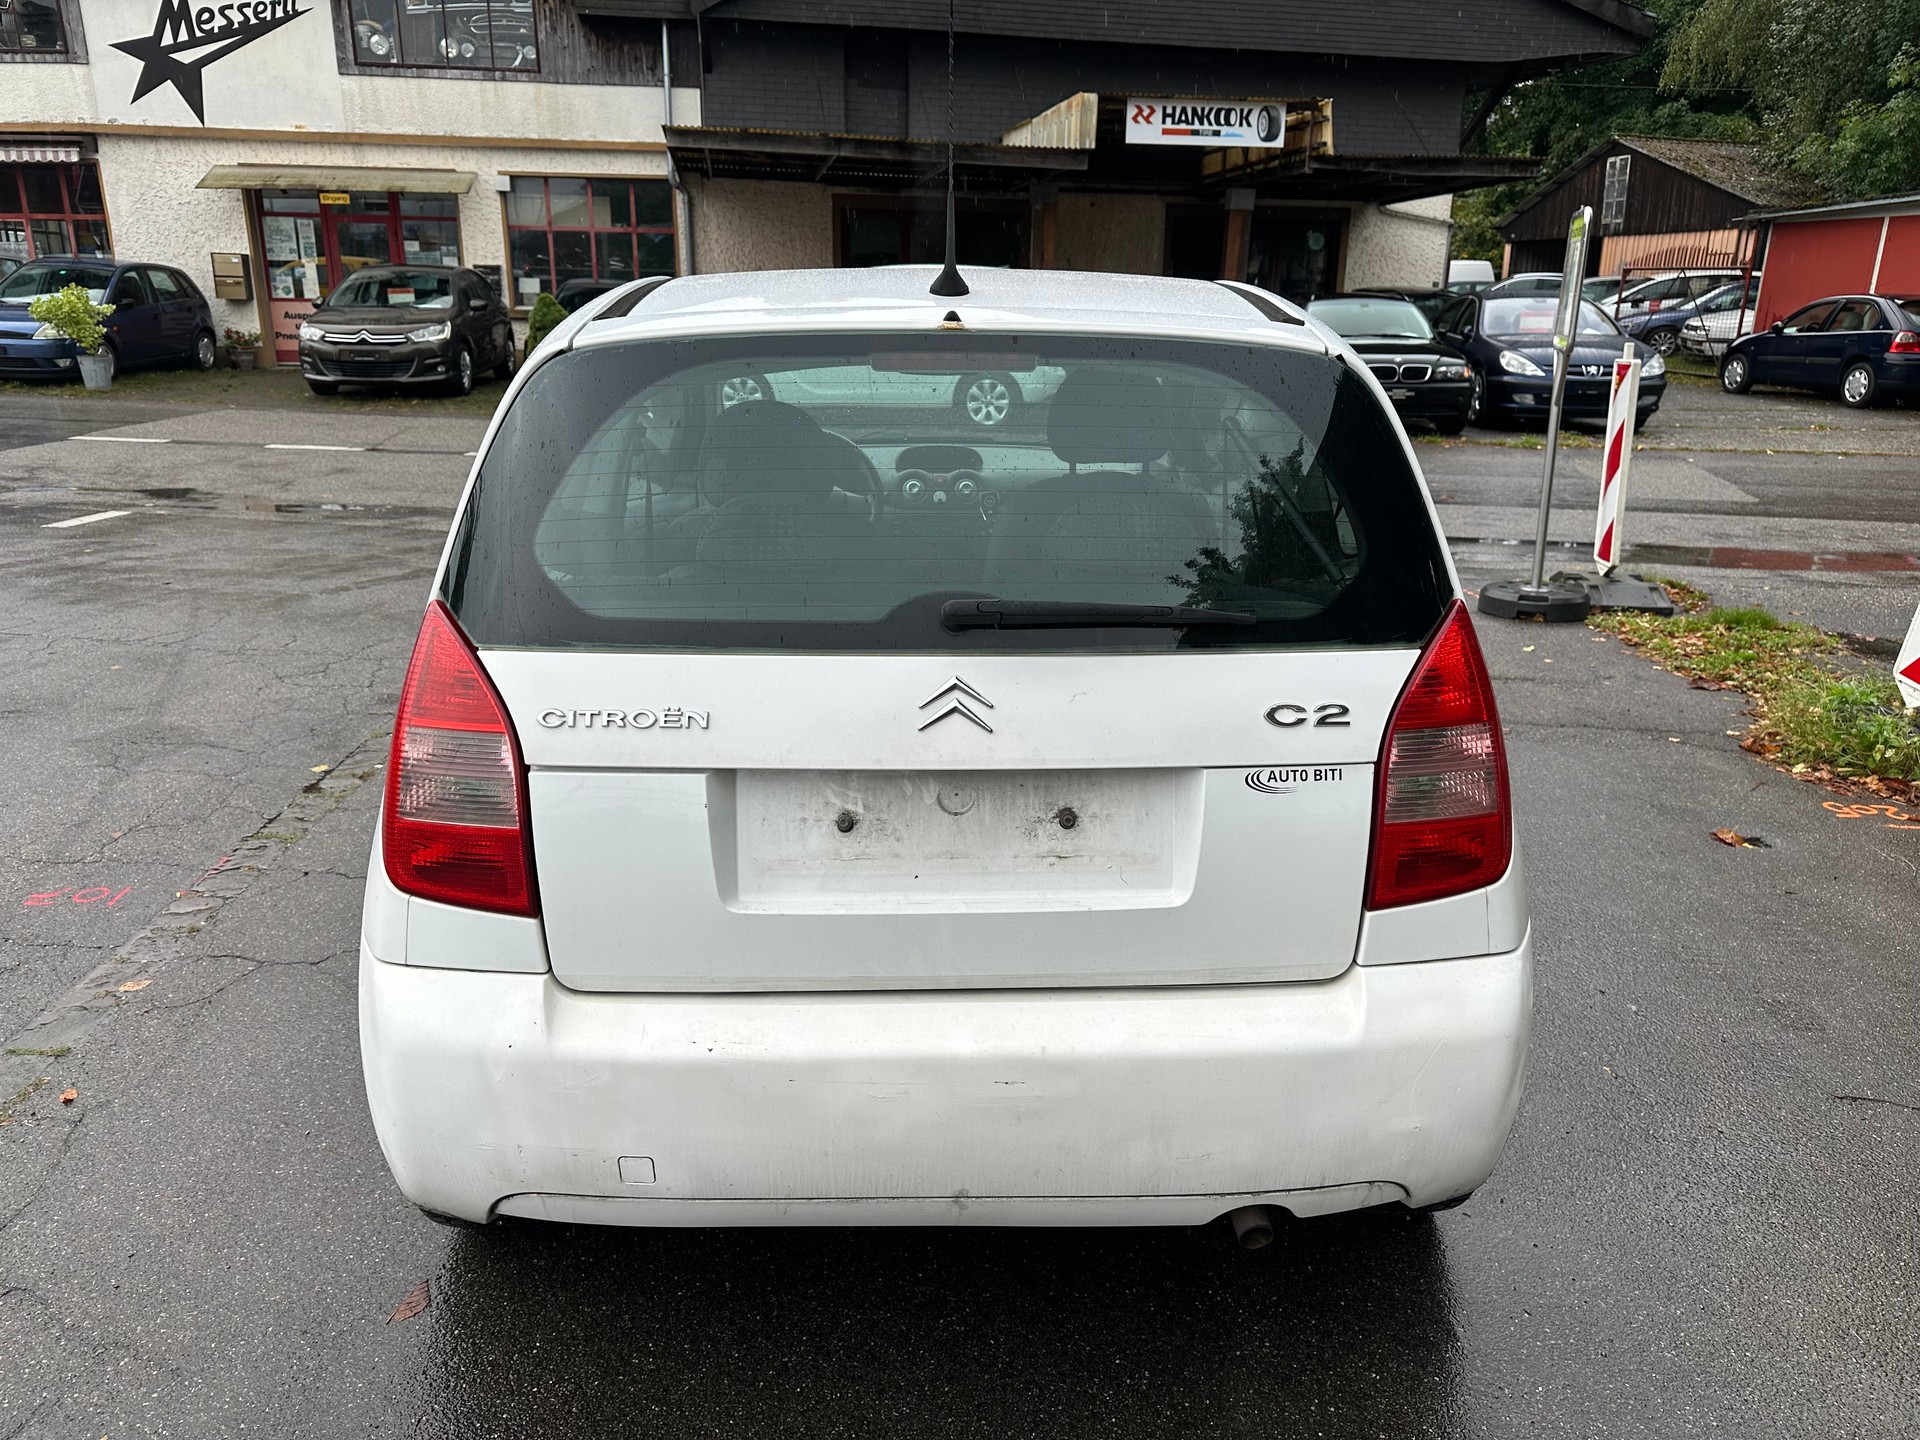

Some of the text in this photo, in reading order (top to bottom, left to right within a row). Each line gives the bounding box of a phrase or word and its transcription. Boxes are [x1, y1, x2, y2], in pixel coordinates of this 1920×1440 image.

[1161, 104, 1254, 128] HANKOOK
[322, 194, 348, 203] Eingang
[283, 310, 312, 321] Ausp
[275, 331, 300, 340] Pneu
[536, 705, 710, 729] CITROËN
[1263, 702, 1351, 728] C2
[1266, 768, 1343, 783] AUTO BITI
